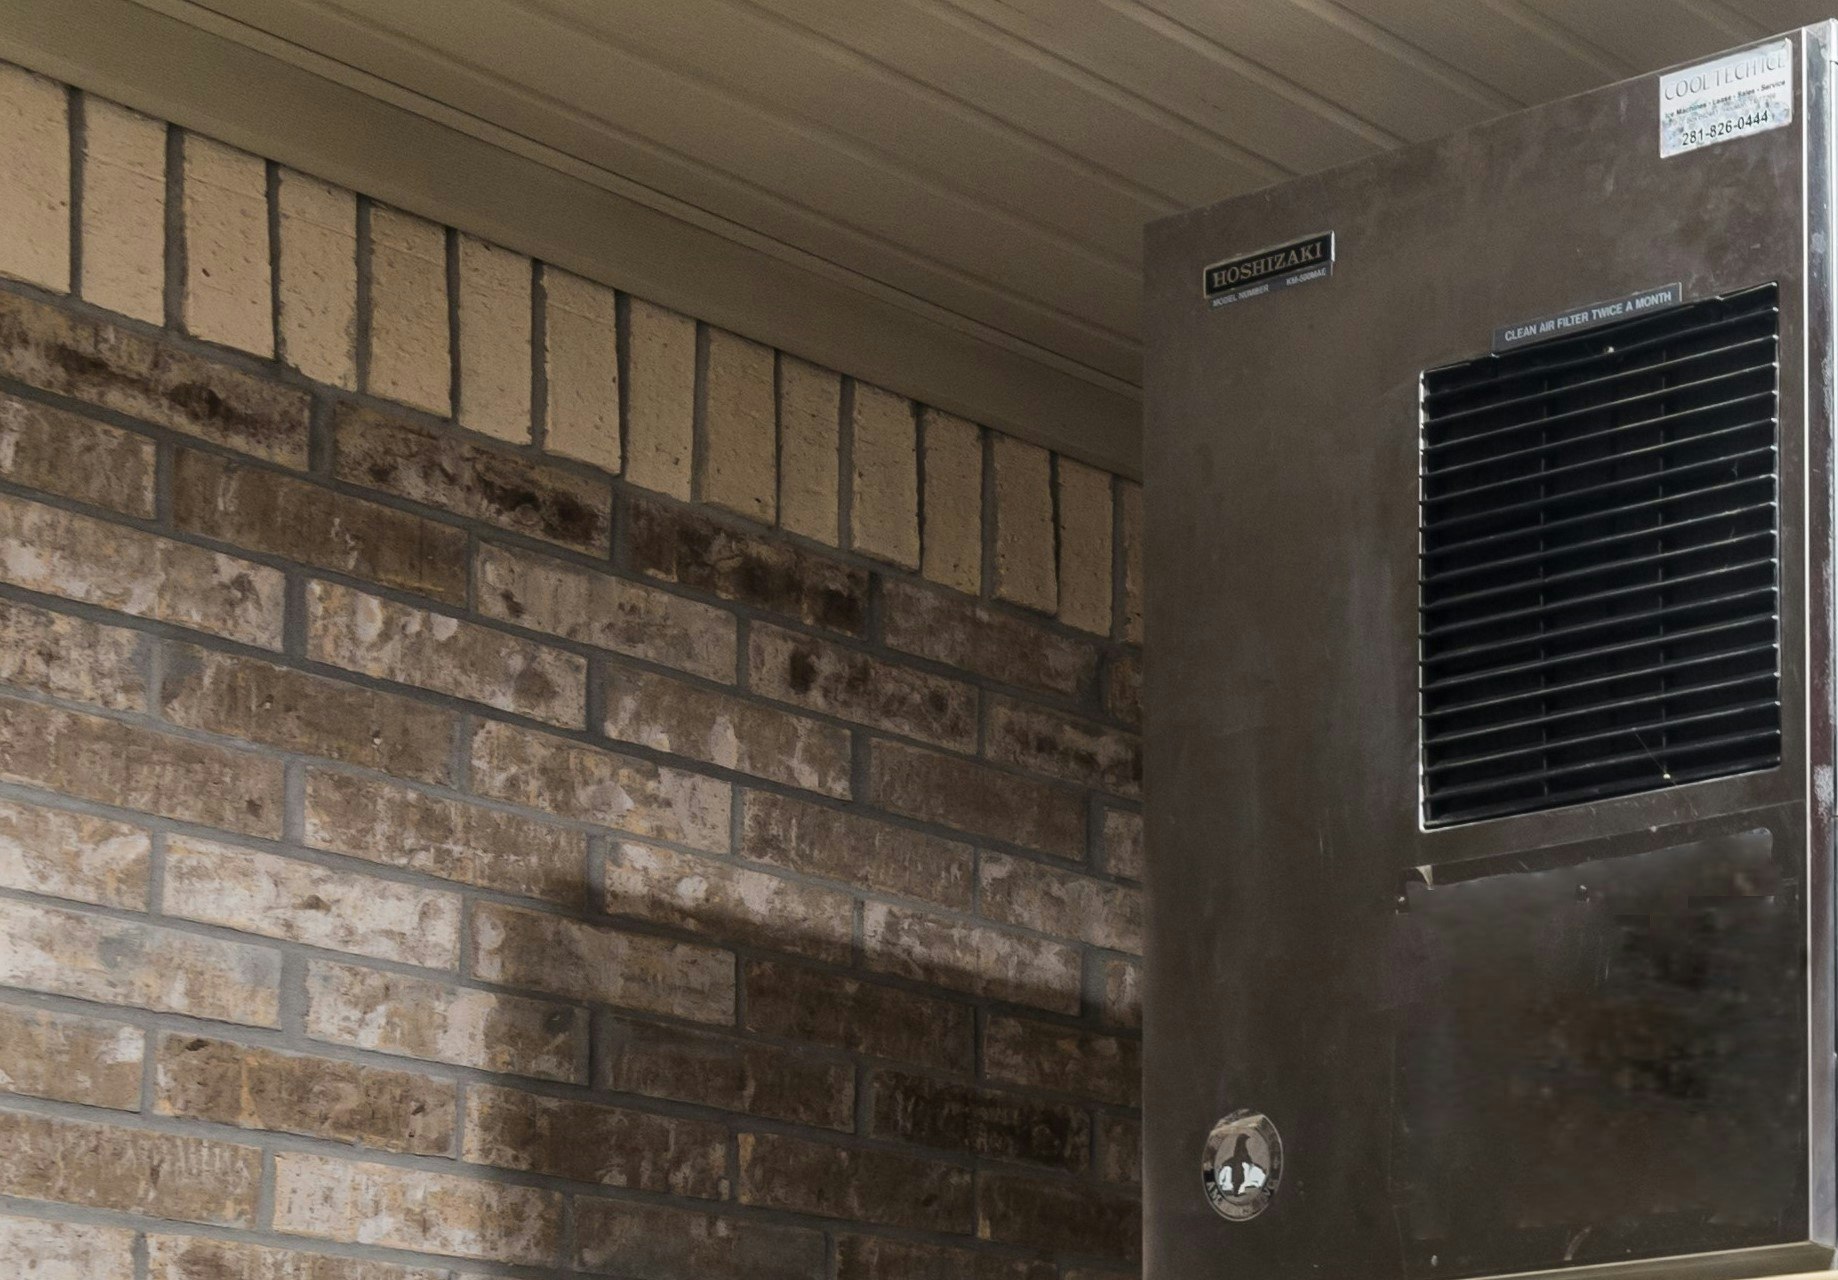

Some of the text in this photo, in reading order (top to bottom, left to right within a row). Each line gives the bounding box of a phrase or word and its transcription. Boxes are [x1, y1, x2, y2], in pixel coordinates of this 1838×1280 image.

[1664, 54, 1786, 100] COOL TECH ICE
[1761, 80, 1786, 92] Service
[1681, 110, 1768, 146] 281-826-0444
[1212, 241, 1323, 288] HOSHIZAKI
[1504, 291, 1672, 341] CLEAN AIR FILTER TWICE A MONTH
